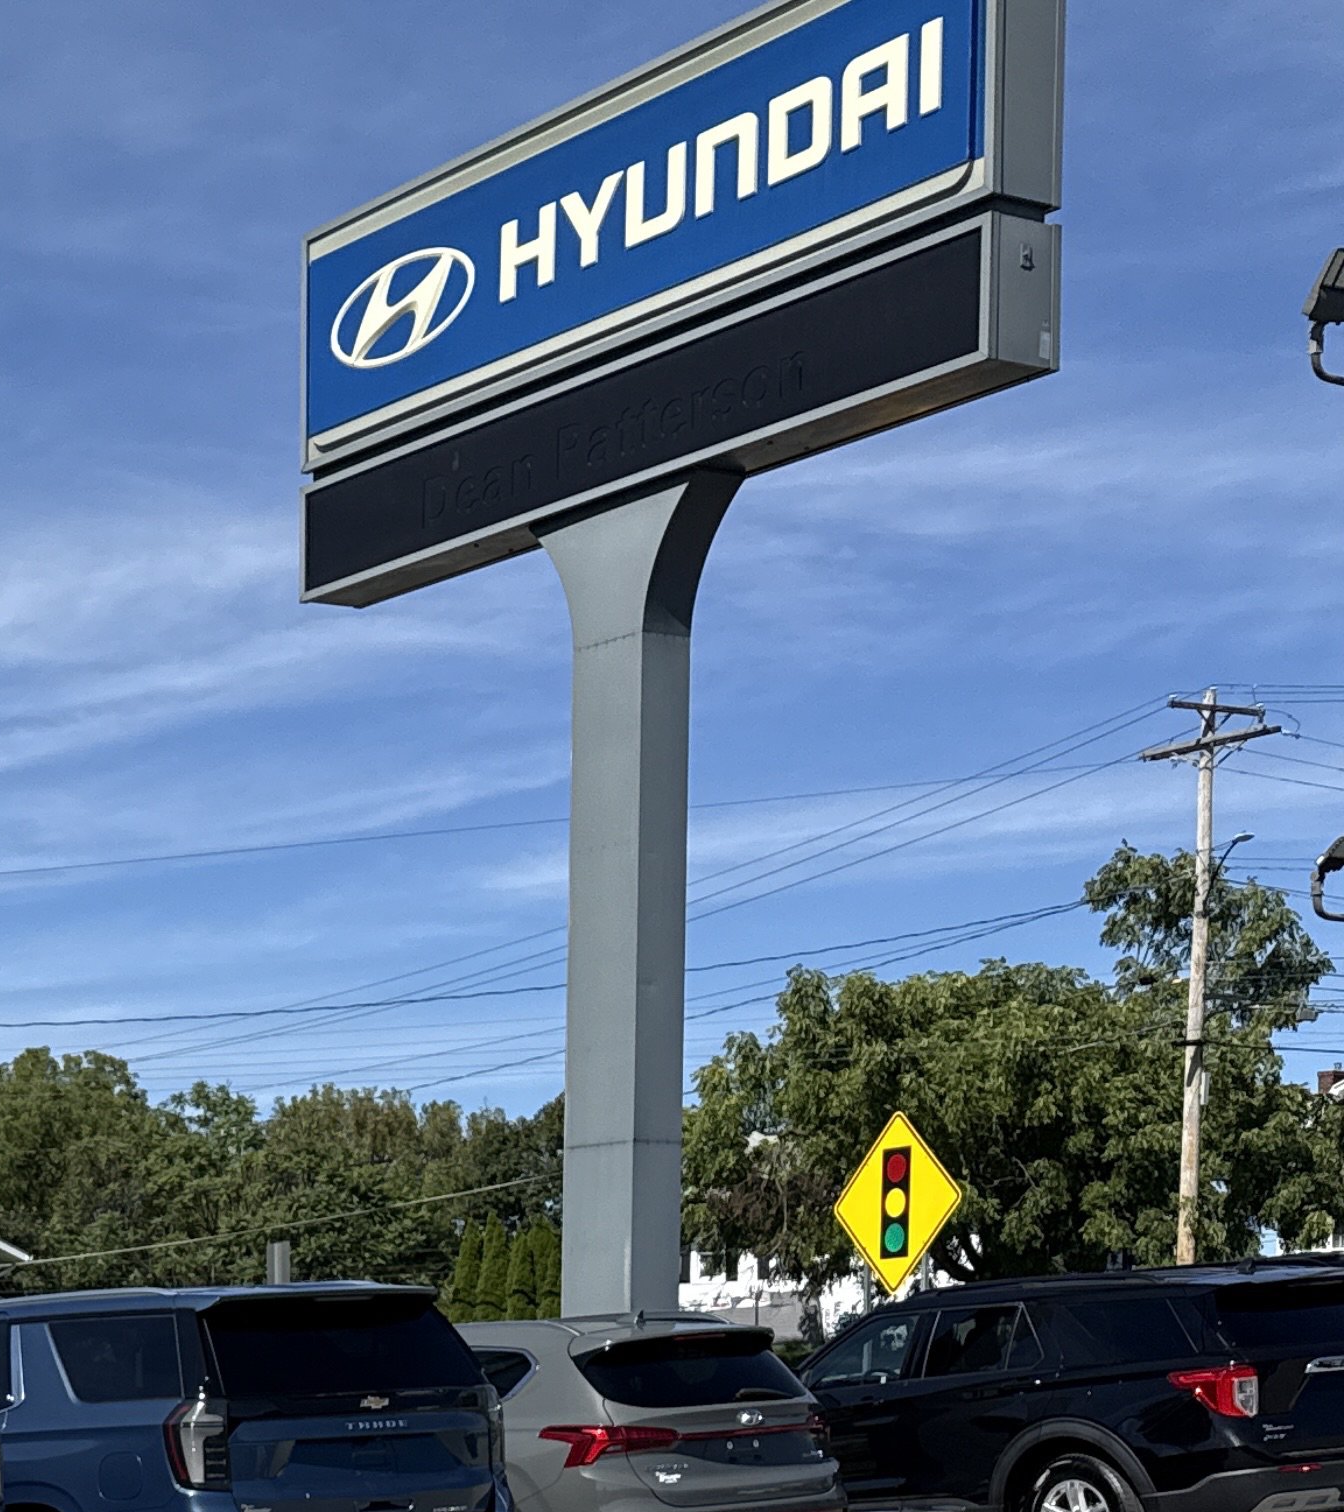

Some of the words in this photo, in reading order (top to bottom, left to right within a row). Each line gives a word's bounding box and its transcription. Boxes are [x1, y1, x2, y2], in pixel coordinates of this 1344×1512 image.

[500, 17, 944, 302] HYUNDAI
[422, 452, 536, 528] Dean
[556, 350, 807, 479] Patterson
